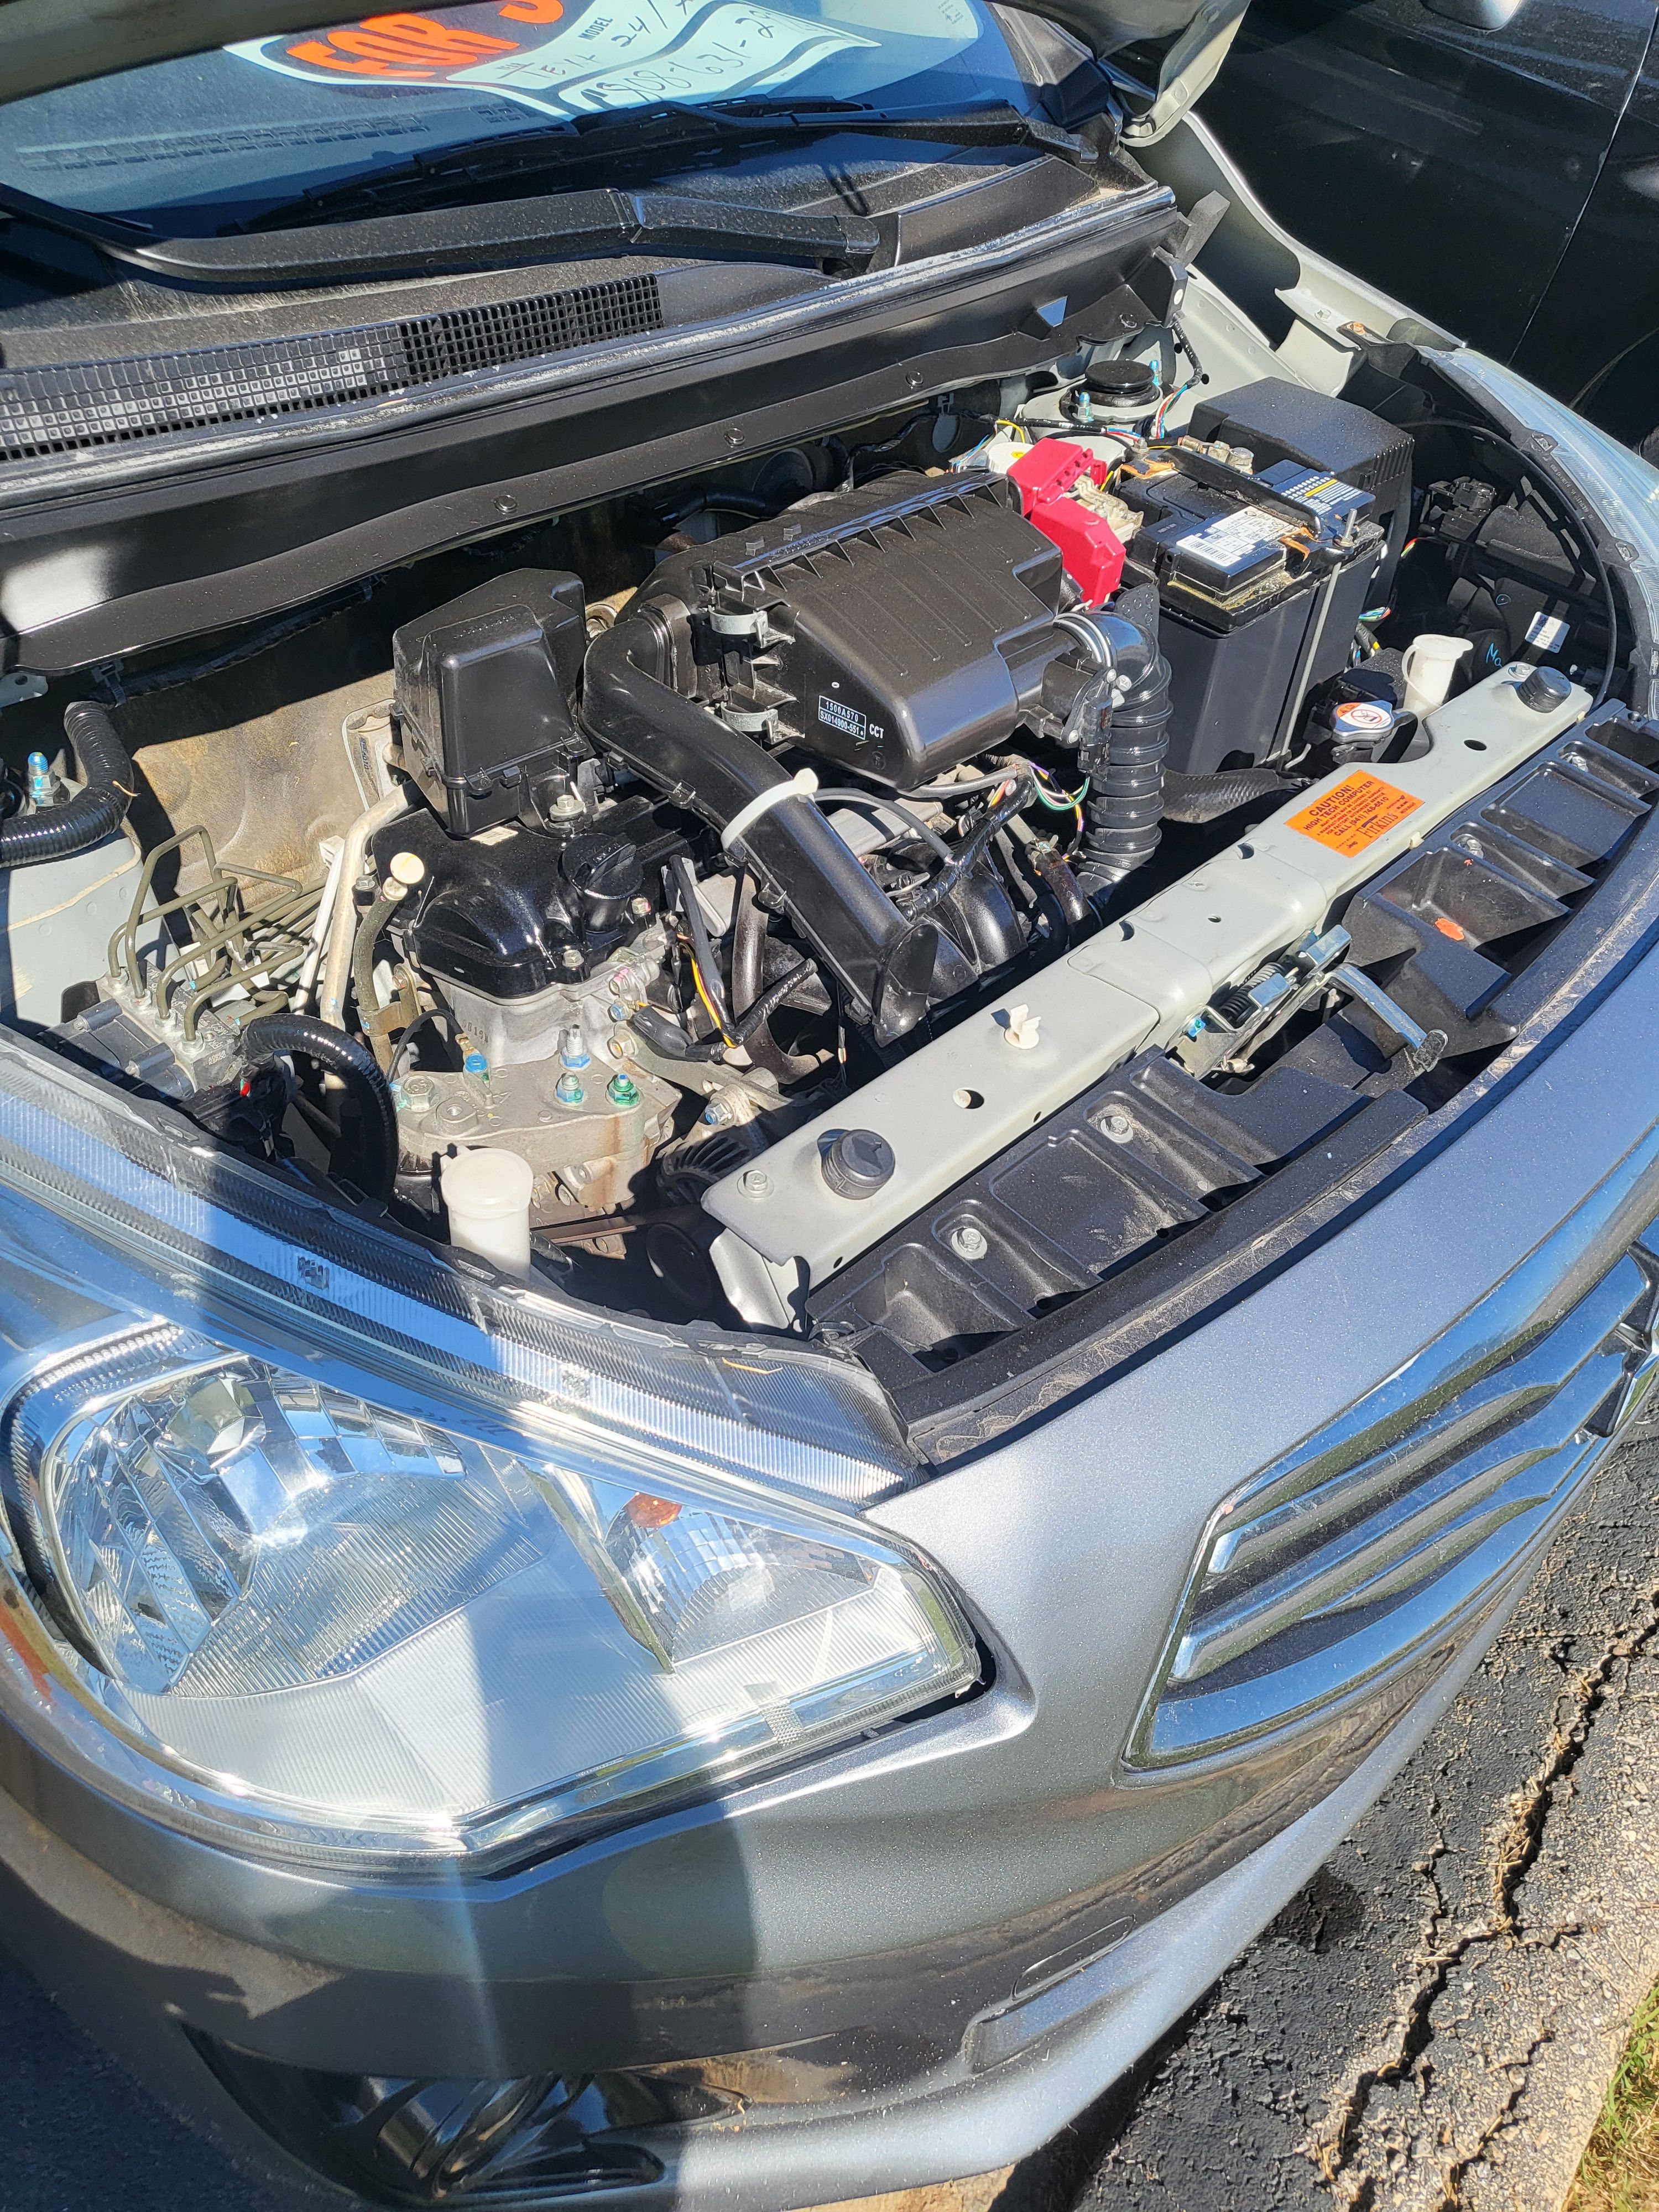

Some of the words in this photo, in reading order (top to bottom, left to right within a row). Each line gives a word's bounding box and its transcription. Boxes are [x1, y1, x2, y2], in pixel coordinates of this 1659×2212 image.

[578, 17, 613, 40] MODEL
[286, 12, 520, 78] FOR
[820, 711, 859, 735] SX014900-551
[826, 701, 859, 722] 1500A570
[869, 723, 884, 739] CCT
[1303, 817, 1322, 830] HIGH
[1319, 805, 1340, 817] TECH
[1338, 780, 1375, 805] COMPUTER
[1309, 785, 1354, 816] CAUTION!
[1320, 819, 1330, 827] MANY
[1352, 793, 1366, 804] COVERED
[1334, 825, 1352, 836] CALL
[1349, 814, 1366, 826] (941)
[1355, 812, 1399, 838] Firkins
